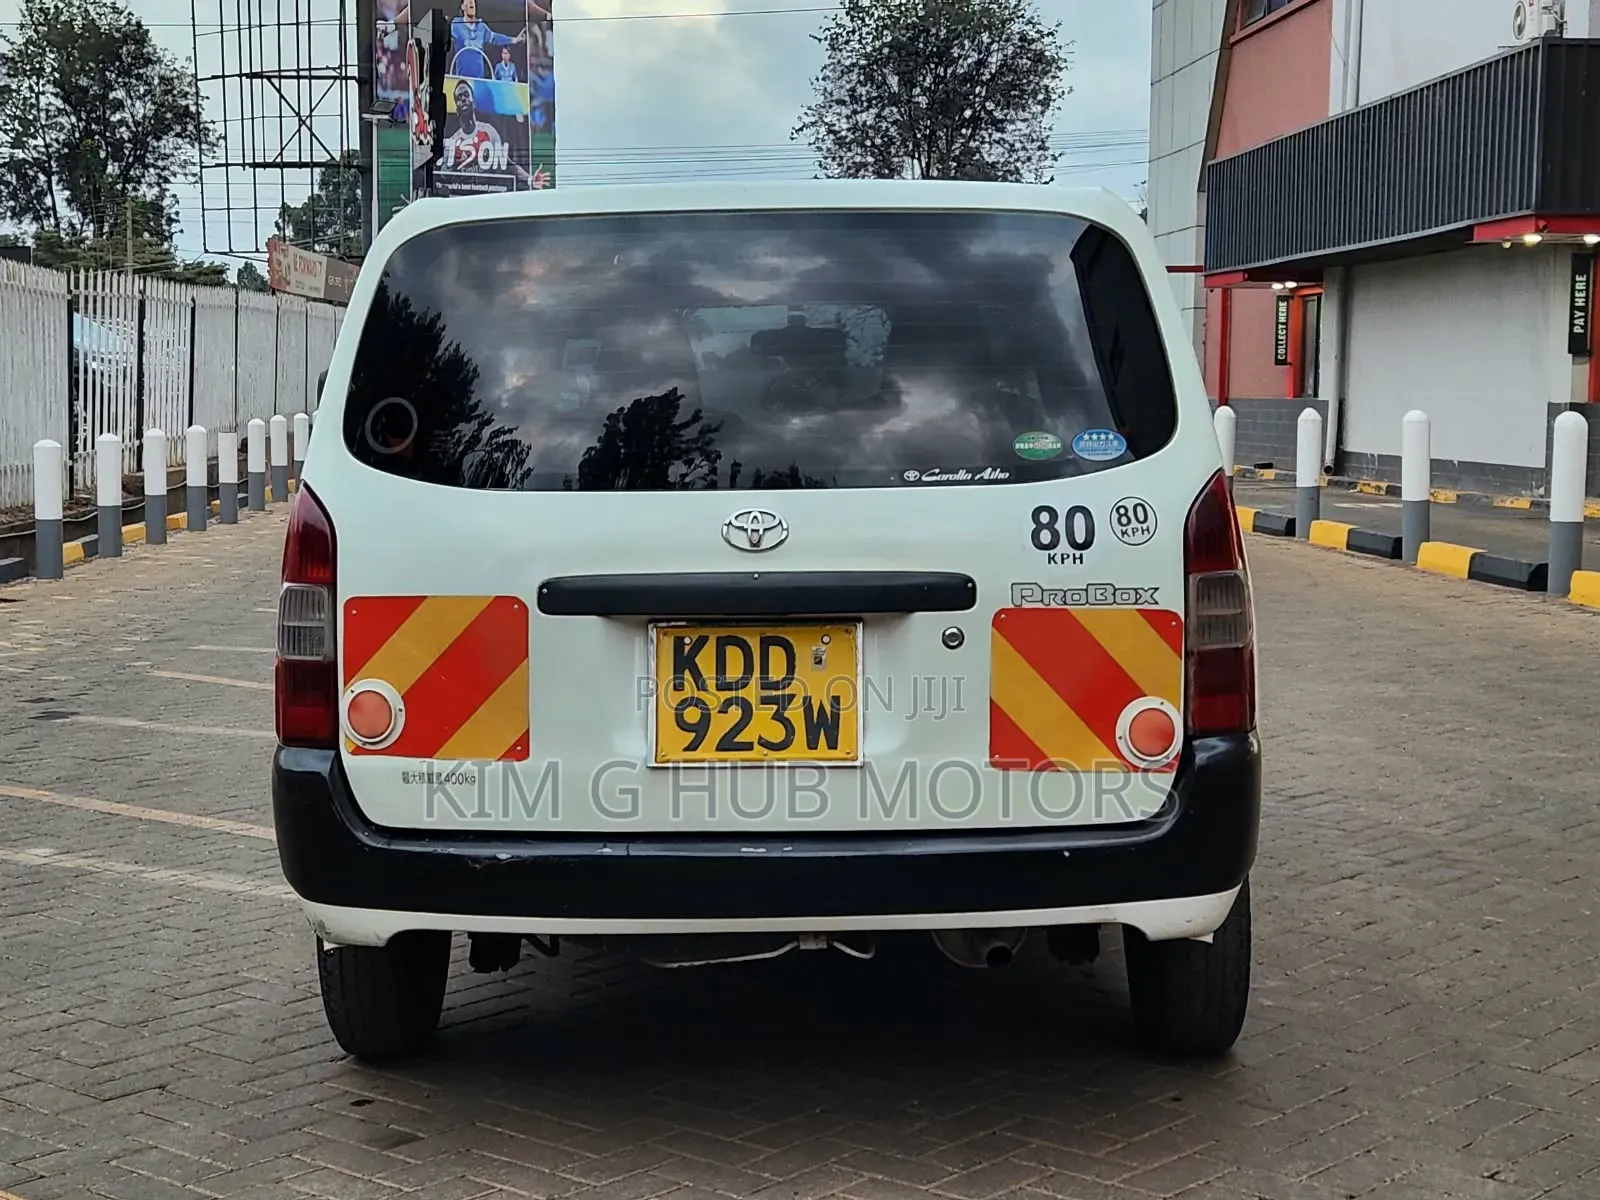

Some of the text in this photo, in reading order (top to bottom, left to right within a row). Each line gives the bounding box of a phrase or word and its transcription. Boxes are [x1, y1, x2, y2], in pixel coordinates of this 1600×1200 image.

[478, 140, 510, 170] ON
[1573, 274, 1587, 334] PAY HERE
[1277, 300, 1288, 360] COLLECT HERE
[1031, 505, 1096, 551] 80
[1115, 502, 1149, 527] 80
[1120, 525, 1151, 538] KPH
[1047, 553, 1084, 564] KPH
[673, 635, 797, 692] KDD
[674, 694, 841, 752] 923W
